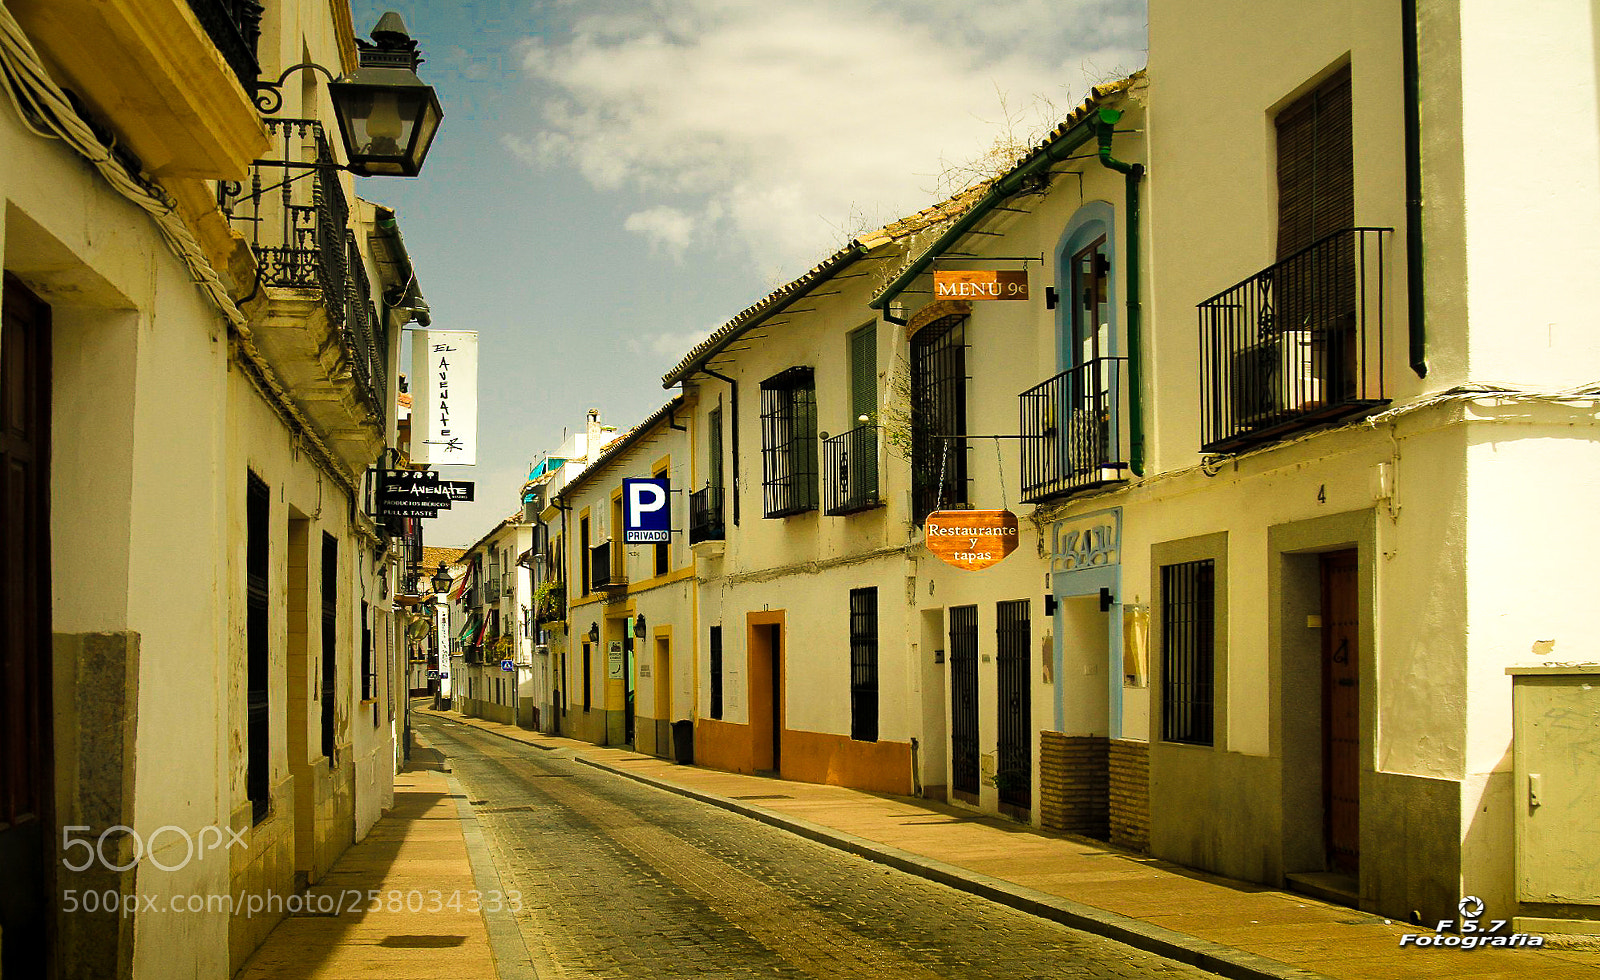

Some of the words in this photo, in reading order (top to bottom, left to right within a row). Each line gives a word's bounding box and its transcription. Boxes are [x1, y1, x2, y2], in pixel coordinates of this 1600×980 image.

[938, 279, 1002, 296] MENÚ
[432, 343, 457, 352] EL
[385, 484, 410, 493] EL
[1317, 484, 1326, 504] 4
[629, 483, 666, 528] P
[628, 531, 668, 541] PRIVADO
[928, 524, 1016, 537] Restaurante
[969, 538, 978, 549] y
[954, 552, 992, 564] tapas
